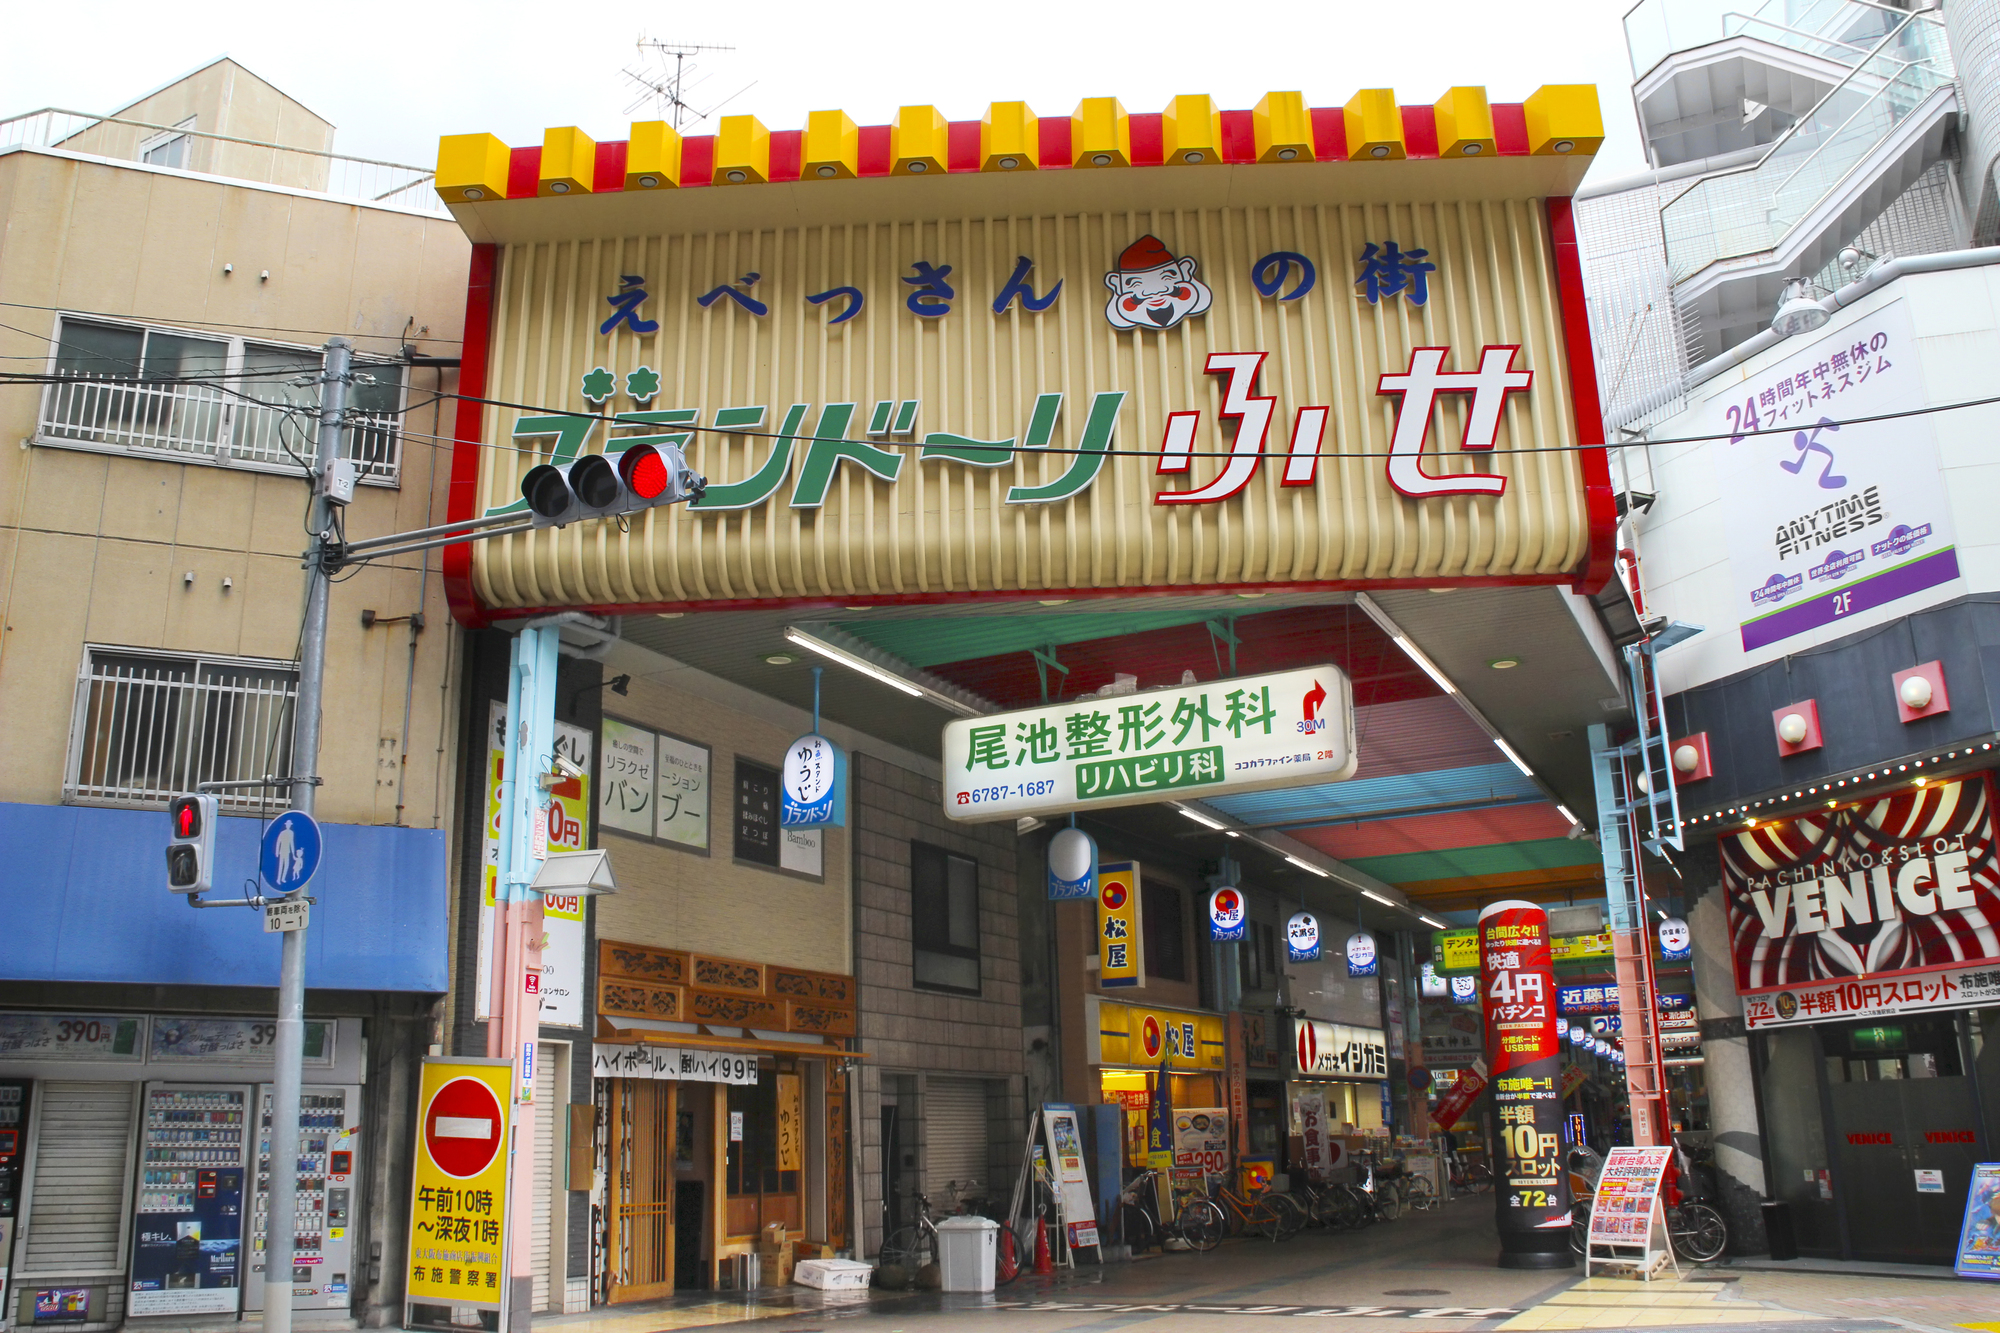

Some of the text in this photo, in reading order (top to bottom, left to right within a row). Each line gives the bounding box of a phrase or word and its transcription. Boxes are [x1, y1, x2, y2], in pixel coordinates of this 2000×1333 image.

[1763, 355, 1893, 427] フィットネスジム
[1775, 485, 1880, 546] ANYTIME
[1779, 506, 1883, 561] FITNESS
[1832, 591, 1852, 615] 2F
[965, 686, 1277, 773] 尾池整形外科
[1296, 718, 1326, 733] 30M
[1080, 749, 1218, 795] リハビリ科
[1235, 750, 1334, 771] ココカラファイン薬局 2階
[798, 747, 812, 801] ゆうじ
[972, 779, 1055, 803] 6787-1687
[783, 800, 833, 825] ブランドーリ
[1751, 850, 1977, 939] VENICE
[1214, 909, 1240, 921] 松屋
[1103, 915, 1129, 969] 松屋
[1487, 951, 1520, 971] 快適
[1490, 971, 1544, 1004] 4円
[1800, 974, 1958, 1016] 半額10円スロット
[1492, 1005, 1546, 1021] パチンコ
[56, 1020, 102, 1043] 390
[1165, 1020, 1196, 1059] 松屋
[1500, 1105, 1535, 1124] 半額
[779, 1109, 790, 1166] ゆうじ
[1500, 1125, 1559, 1160] 10円
[1846, 1130, 1976, 1145] VENICE VENICE
[1195, 1150, 1224, 1174] 290
[1505, 1157, 1562, 1178] スロット
[418, 1185, 493, 1216] 午前10時
[1509, 1189, 1558, 1207] 全72台
[413, 1265, 497, 1289] 布施警察署
